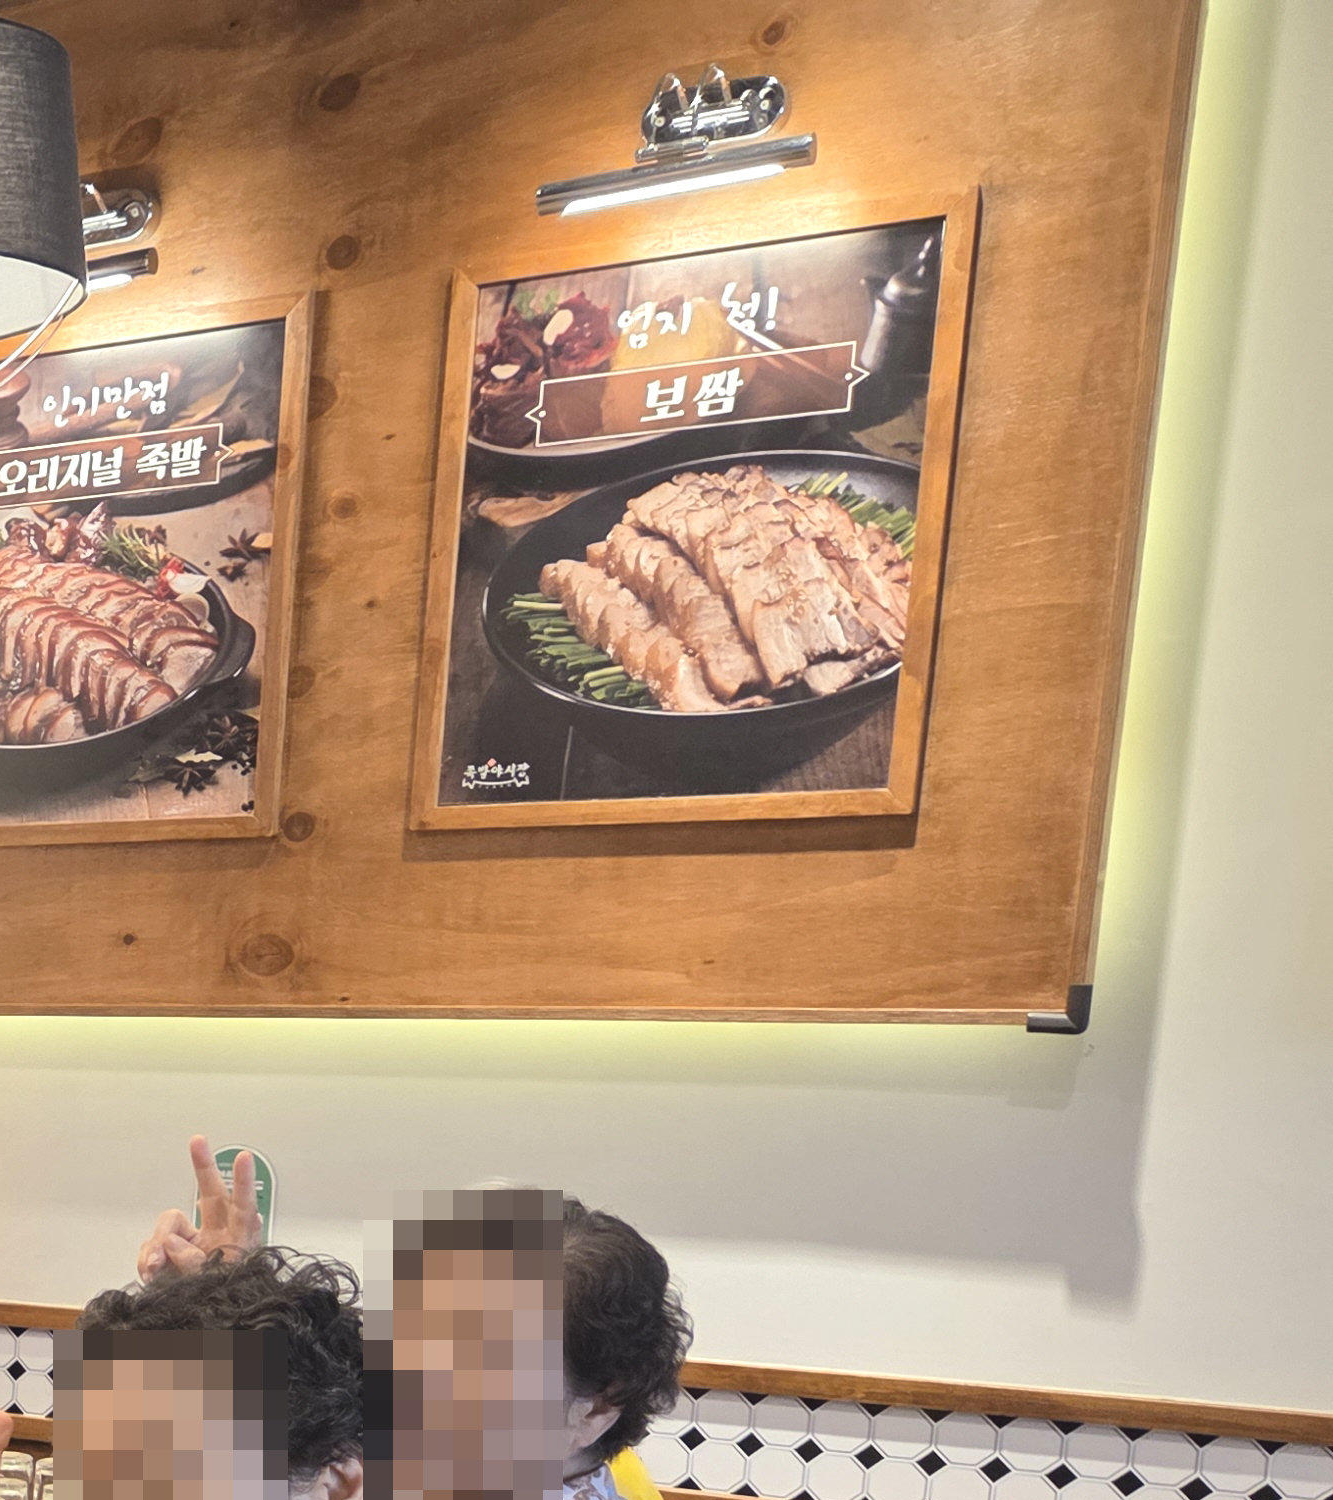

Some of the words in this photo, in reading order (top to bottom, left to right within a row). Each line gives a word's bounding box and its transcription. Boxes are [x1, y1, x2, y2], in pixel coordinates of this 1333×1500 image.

[617, 301, 692, 349] 엄지
[43, 372, 169, 428] 인기만점
[640, 367, 744, 422] 보쌈
[136, 436, 207, 480] 족발
